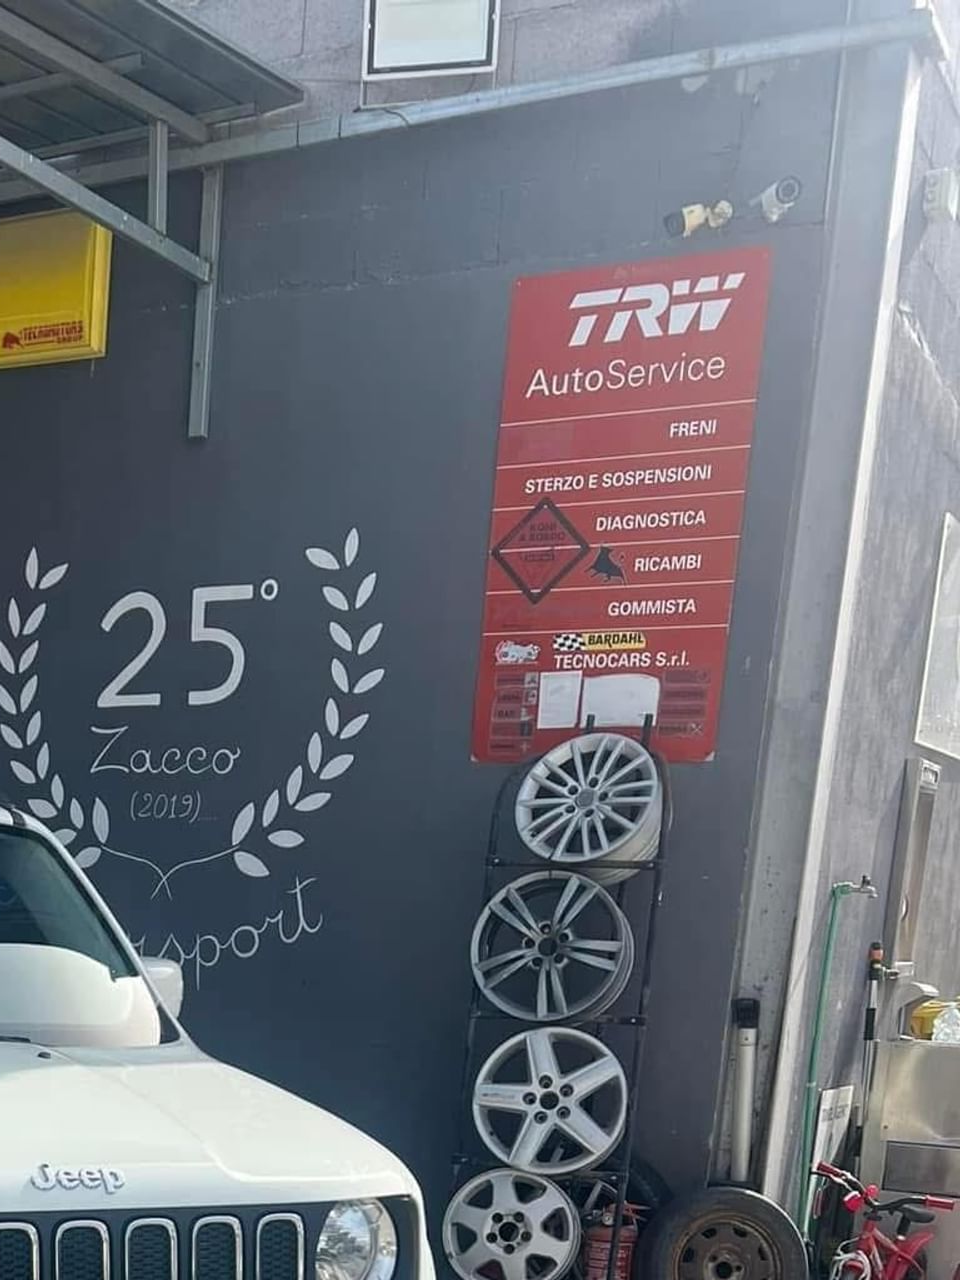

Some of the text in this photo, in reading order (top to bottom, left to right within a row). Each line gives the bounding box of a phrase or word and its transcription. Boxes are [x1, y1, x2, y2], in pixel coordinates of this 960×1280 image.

[568, 272, 746, 348] TRW
[525, 352, 726, 399] AutoService
[669, 419, 718, 439] FRENI
[524, 465, 712, 494] STERZO E SOSPENSIONI
[595, 510, 707, 533] DIAGNOSTICA
[634, 554, 702, 573] RICAMBI
[607, 598, 697, 617] GOMMISTA
[587, 631, 644, 648] BARDAHL
[553, 650, 690, 670] TECNOCARS S.r.l.
[89, 725, 241, 774] Zacco
[129, 790, 202, 823] (2019)
[31, 1163, 126, 1194] Jeep
